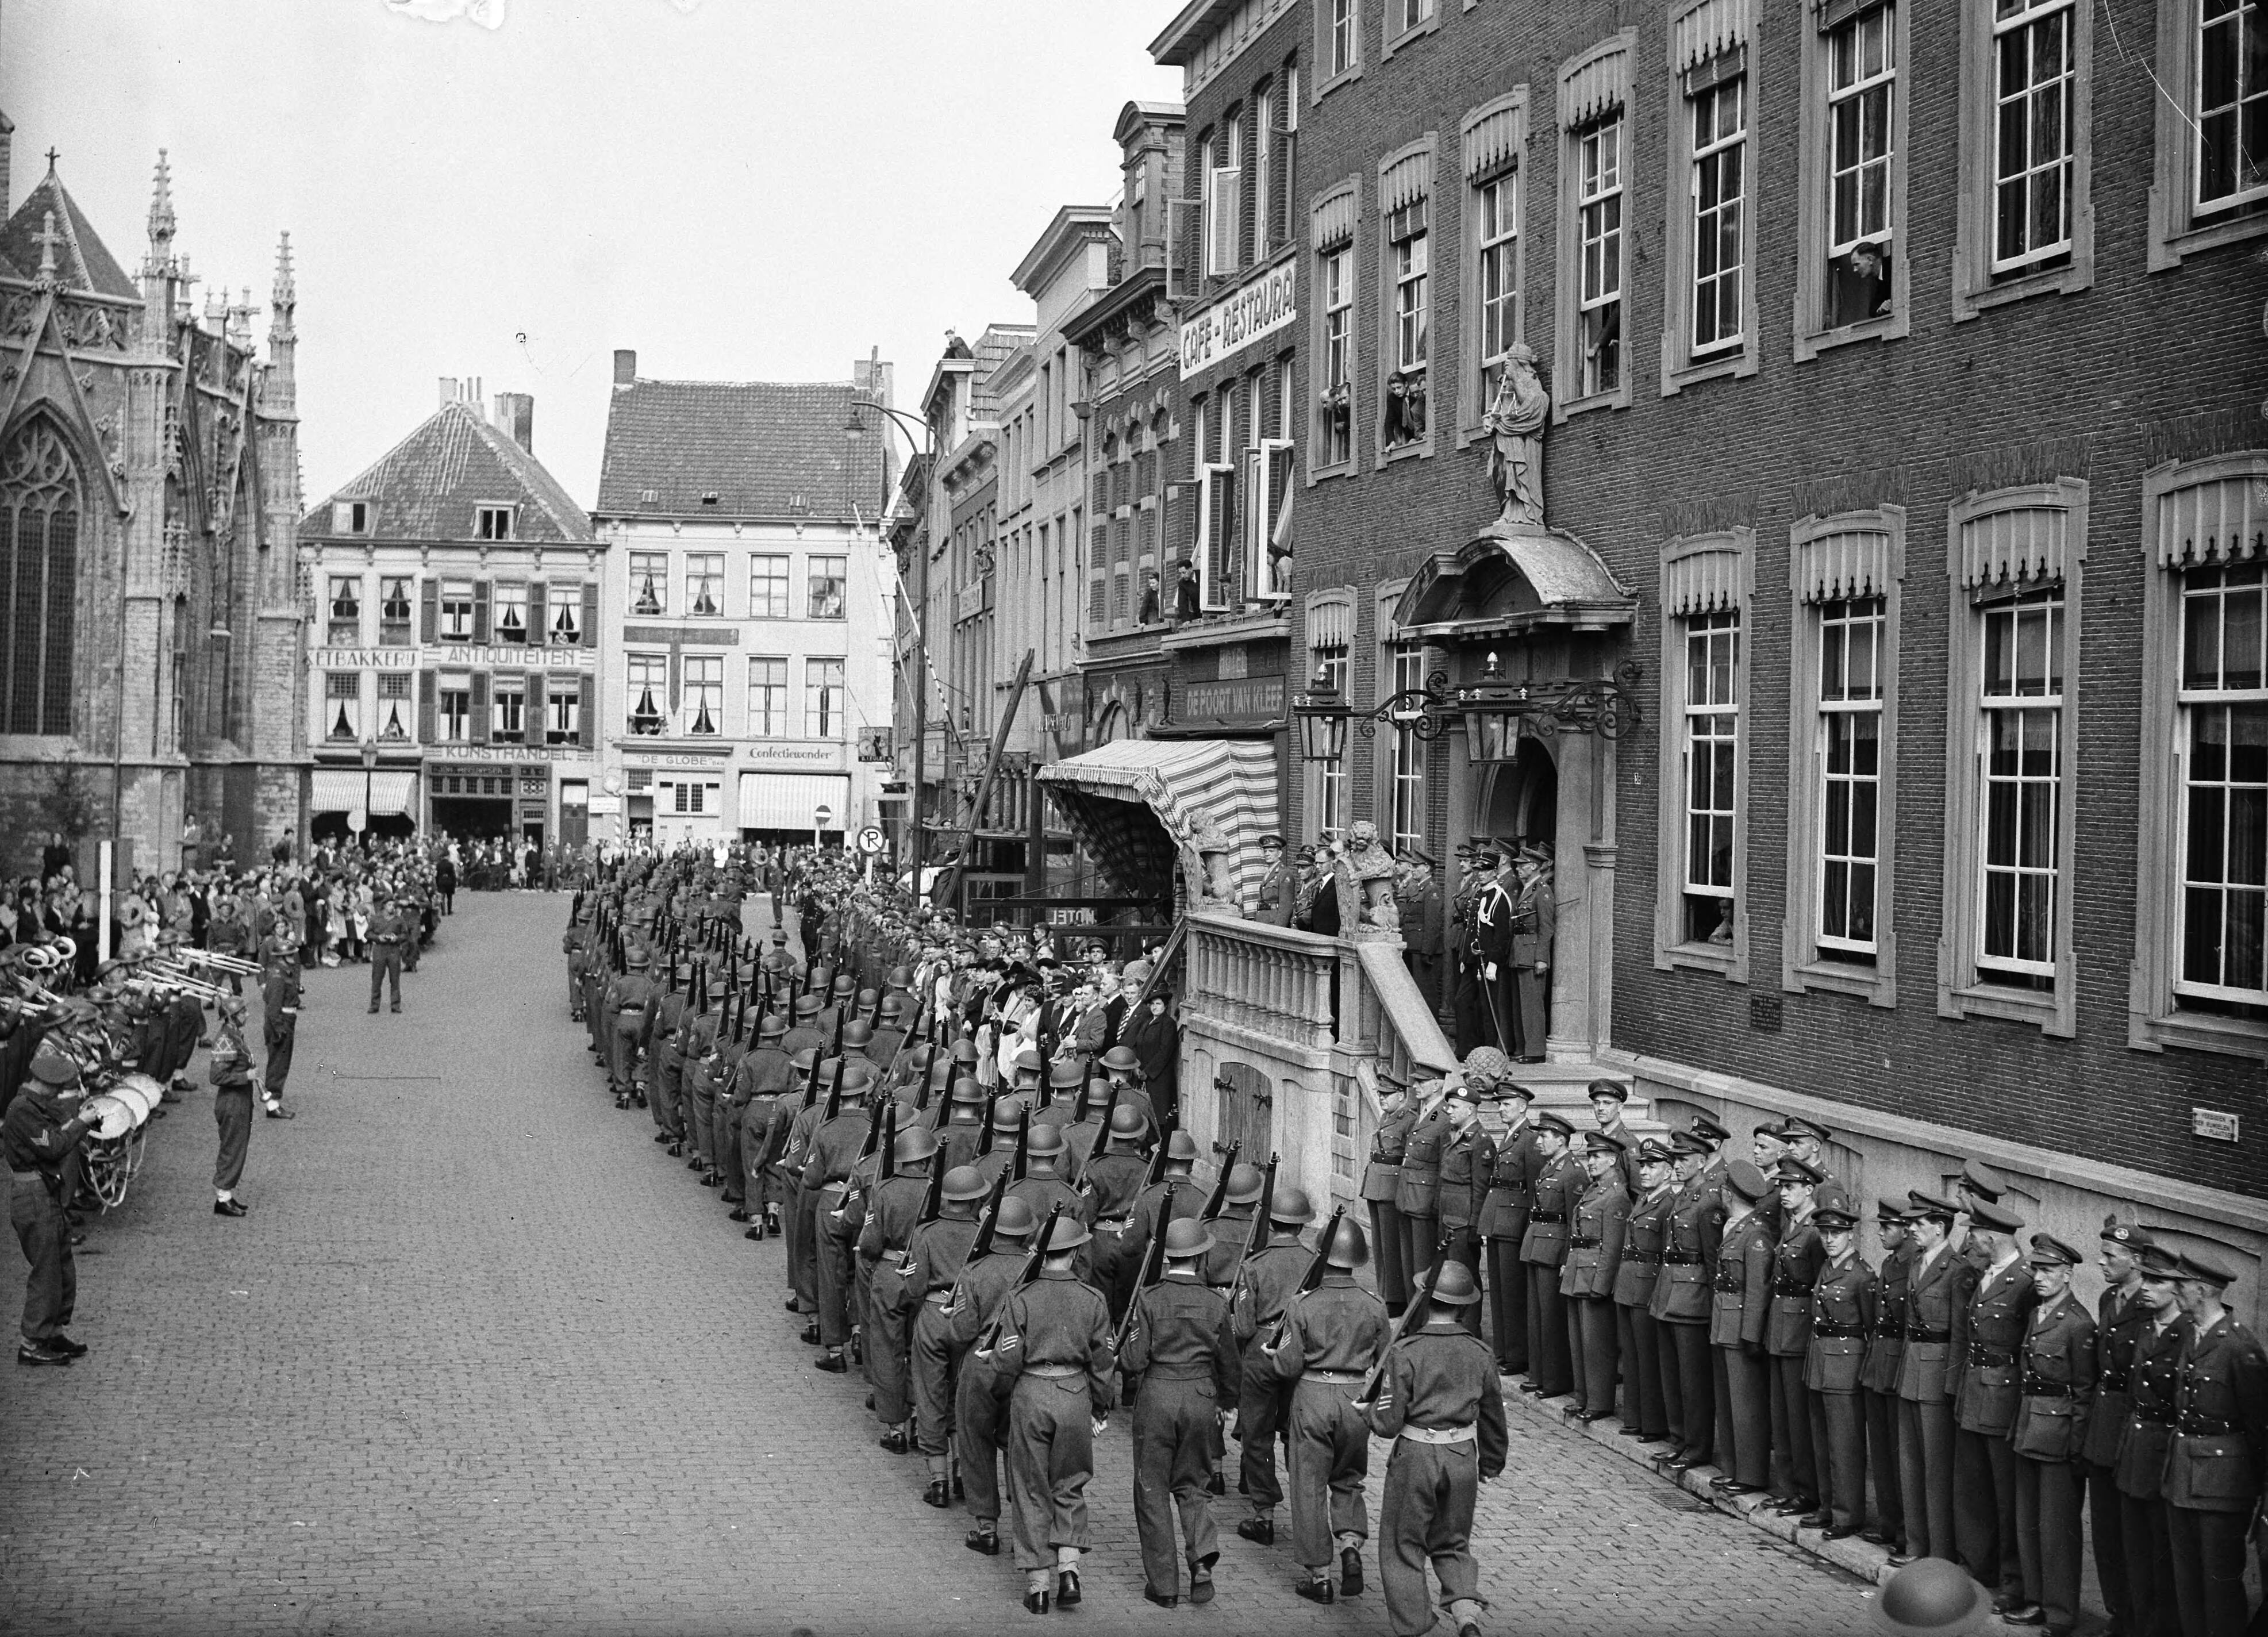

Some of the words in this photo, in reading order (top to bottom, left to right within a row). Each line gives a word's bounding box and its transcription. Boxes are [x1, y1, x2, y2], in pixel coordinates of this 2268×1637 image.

[1183, 316, 1212, 370] CAFE
[1223, 268, 1296, 349] RESTAURA
[448, 646, 574, 666] ANTIQUITEITEN
[1187, 689, 1198, 716] DE
[1200, 687, 1231, 716] POORT
[1233, 685, 1251, 714] VAN
[1253, 684, 1284, 713] KLEEF
[446, 747, 573, 761] KUNSTHANDEL
[749, 746, 832, 759] Confectiewonder
[867, 831, 878, 848] P
